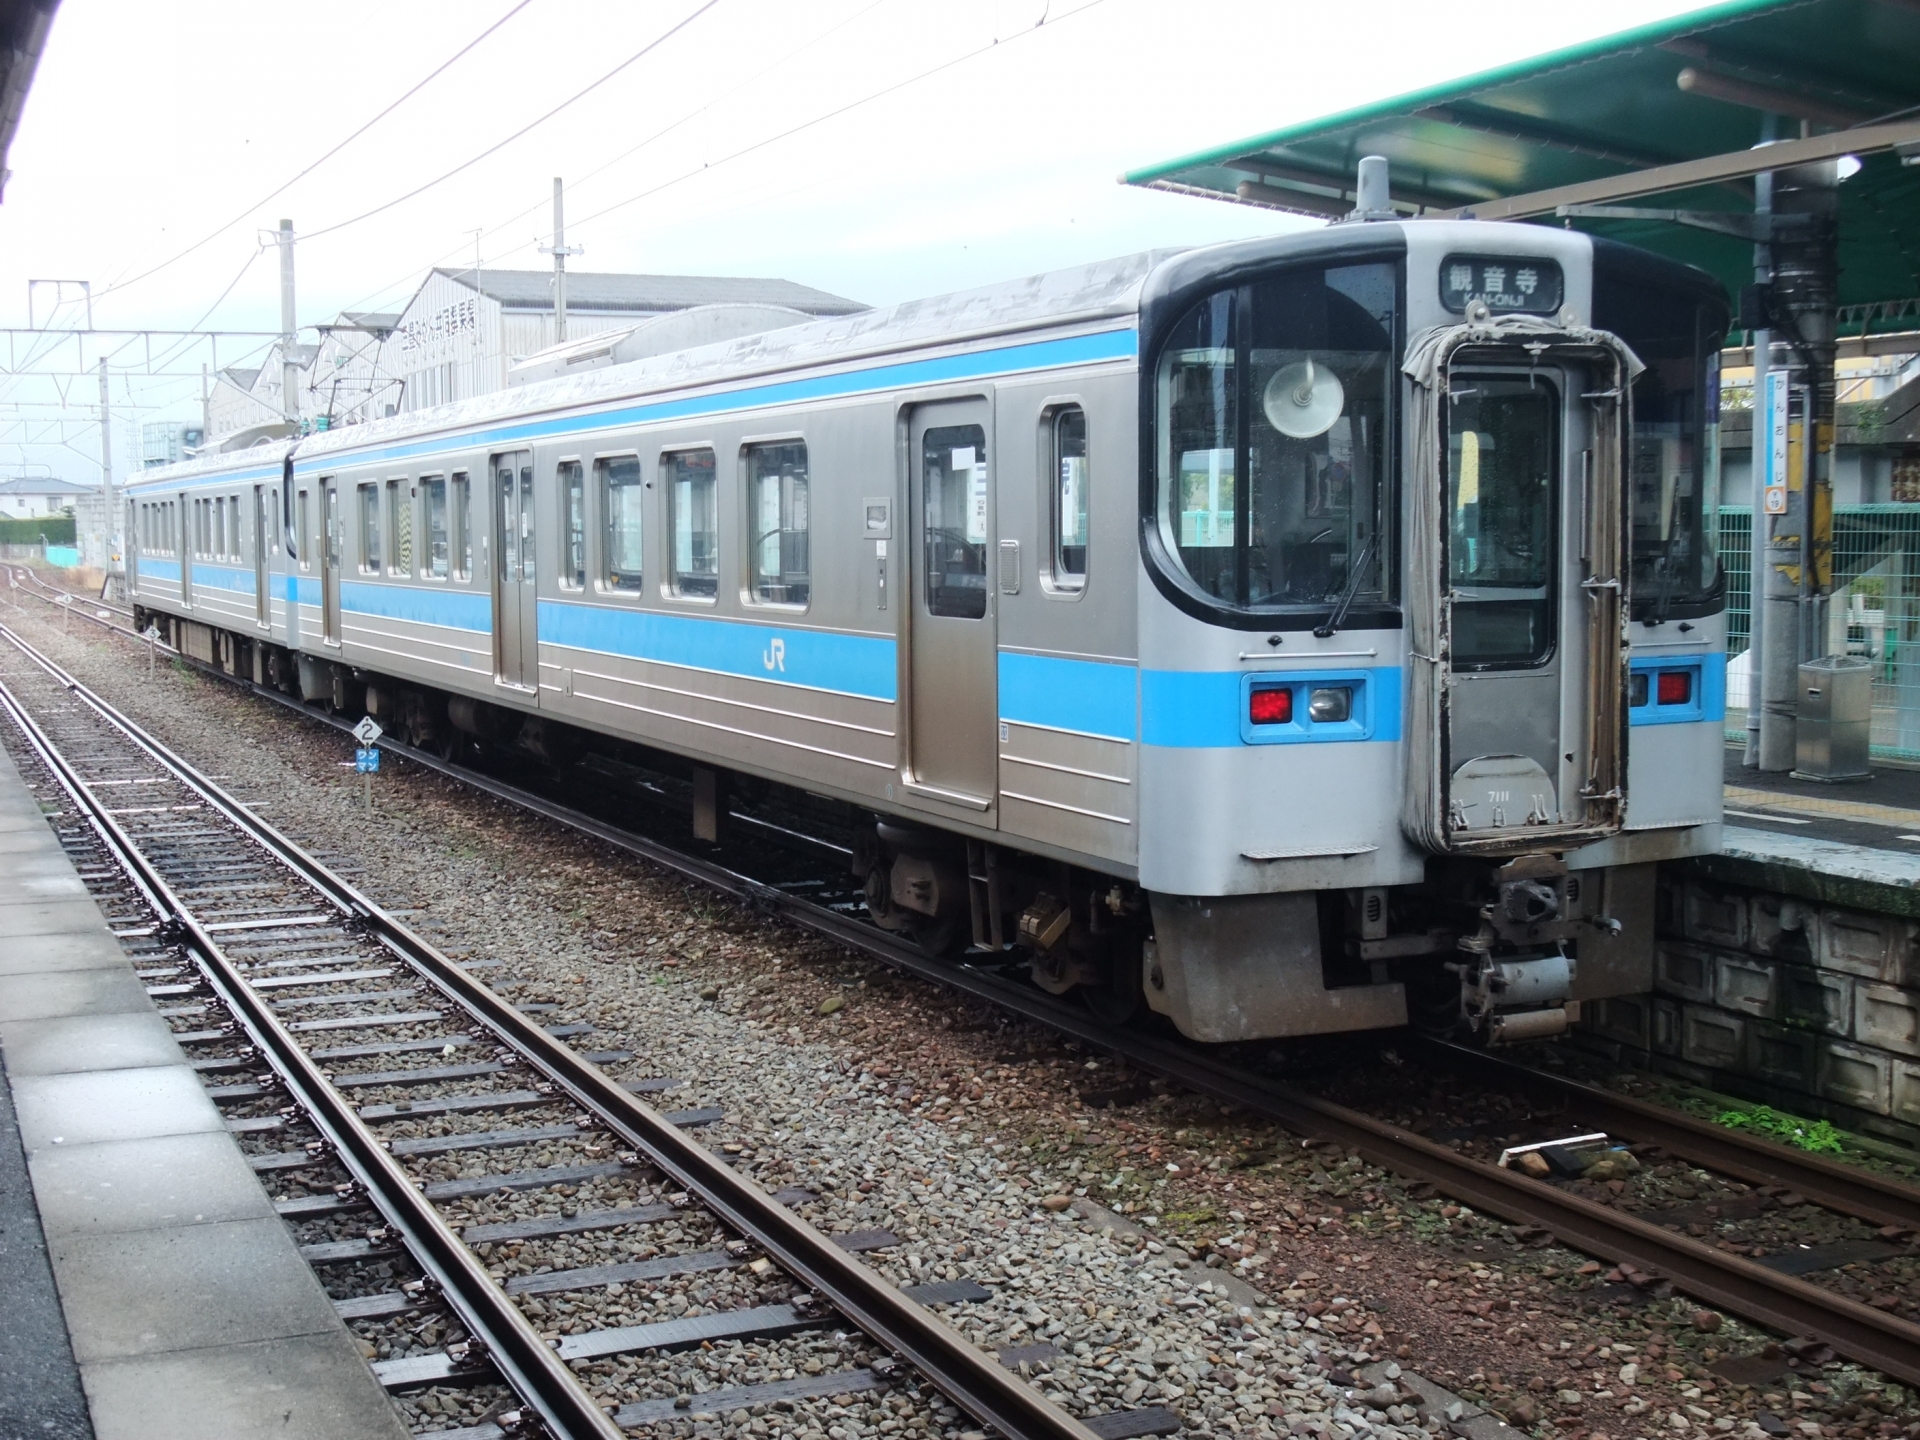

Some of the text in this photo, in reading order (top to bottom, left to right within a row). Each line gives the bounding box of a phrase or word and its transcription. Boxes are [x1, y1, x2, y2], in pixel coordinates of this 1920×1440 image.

[1449, 264, 1538, 295] 観音寺
[1774, 378, 1785, 483] かんおんじ
[763, 637, 785, 672] JR
[361, 723, 374, 741] 2
[358, 751, 377, 760] ワン
[358, 762, 377, 771] マン
[1488, 790, 1509, 803] 7111
